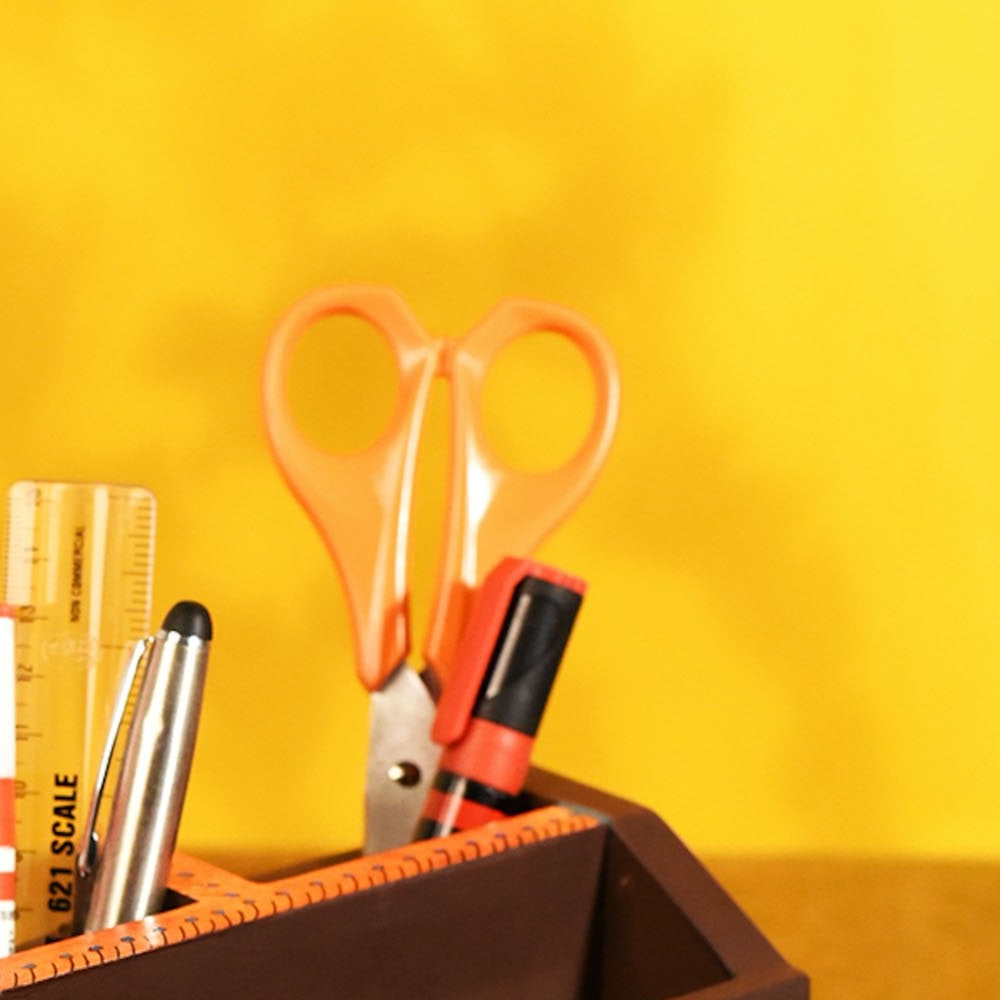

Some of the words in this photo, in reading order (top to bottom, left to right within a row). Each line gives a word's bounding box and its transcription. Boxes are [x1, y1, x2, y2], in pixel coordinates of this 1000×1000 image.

[71, 526, 86, 597] COMMERCIAL
[50, 774, 78, 856] SCALE
[47, 867, 73, 912] 621
